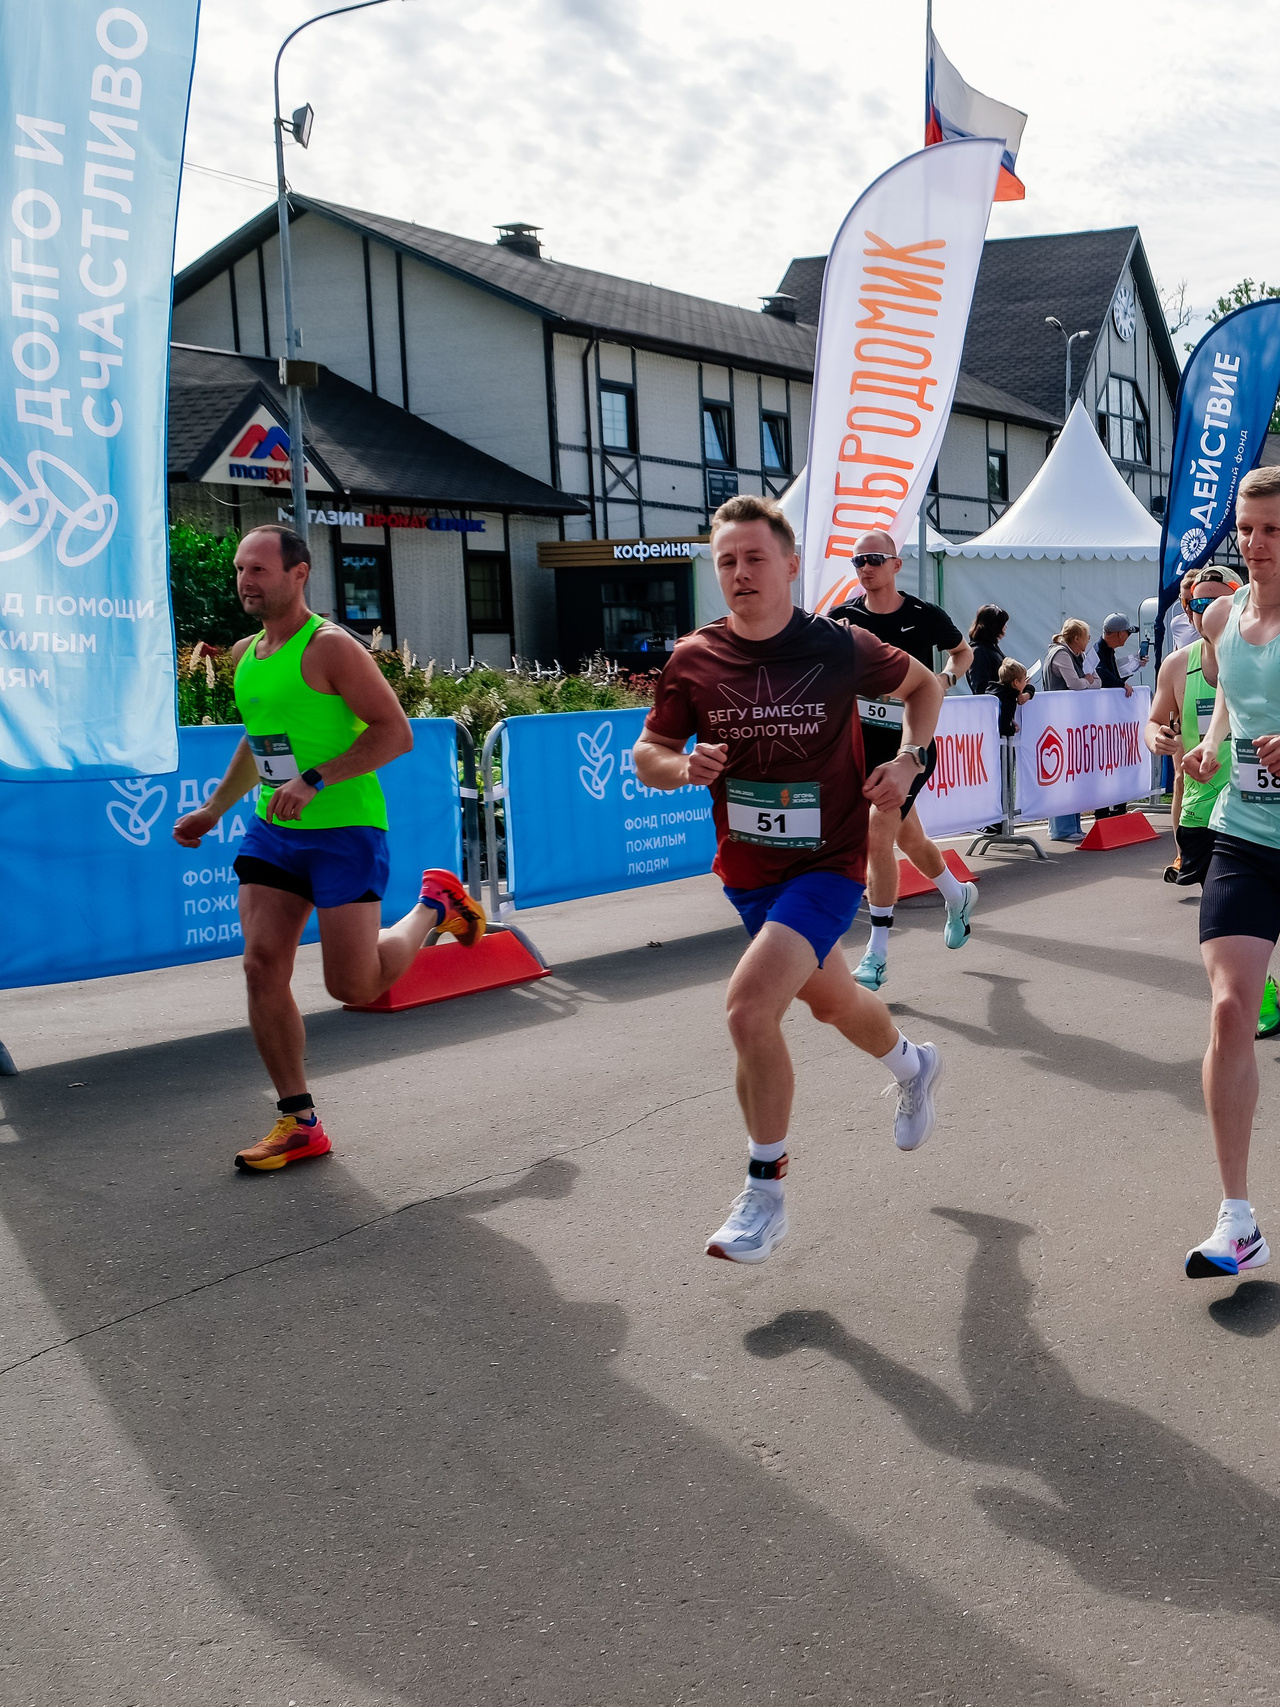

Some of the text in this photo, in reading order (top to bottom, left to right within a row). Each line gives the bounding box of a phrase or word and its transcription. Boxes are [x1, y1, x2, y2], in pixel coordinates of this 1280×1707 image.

[78, 7, 149, 439] СЧАСТЛИВО
[12, 113, 74, 438] ДОЛГО И
[825, 230, 946, 559] ДОБРОДОМИК
[1190, 352, 1241, 530] ДЕЙСТВИЕ
[1234, 429, 1249, 464] фонд
[229, 463, 309, 485] marspot
[277, 506, 364, 528] МГАЗИН
[613, 540, 691, 562] кофейня
[35, 594, 155, 623] ПОМОЩИ
[707, 703, 825, 723] БЕГУ ВМЕСТЕ
[868, 705, 887, 719] 50
[718, 722, 819, 739] С ЗОЛОТЫМ
[1065, 721, 1142, 783] ДОБРОДОМИК
[264, 760, 273, 776] 4
[624, 807, 712, 831] ФОНД ПОМОЩИ
[757, 812, 786, 834] 51
[626, 832, 687, 853] ПОЖИЛЫМ
[182, 866, 239, 886] ФОНД
[627, 857, 670, 876] ЛЮДЯМ
